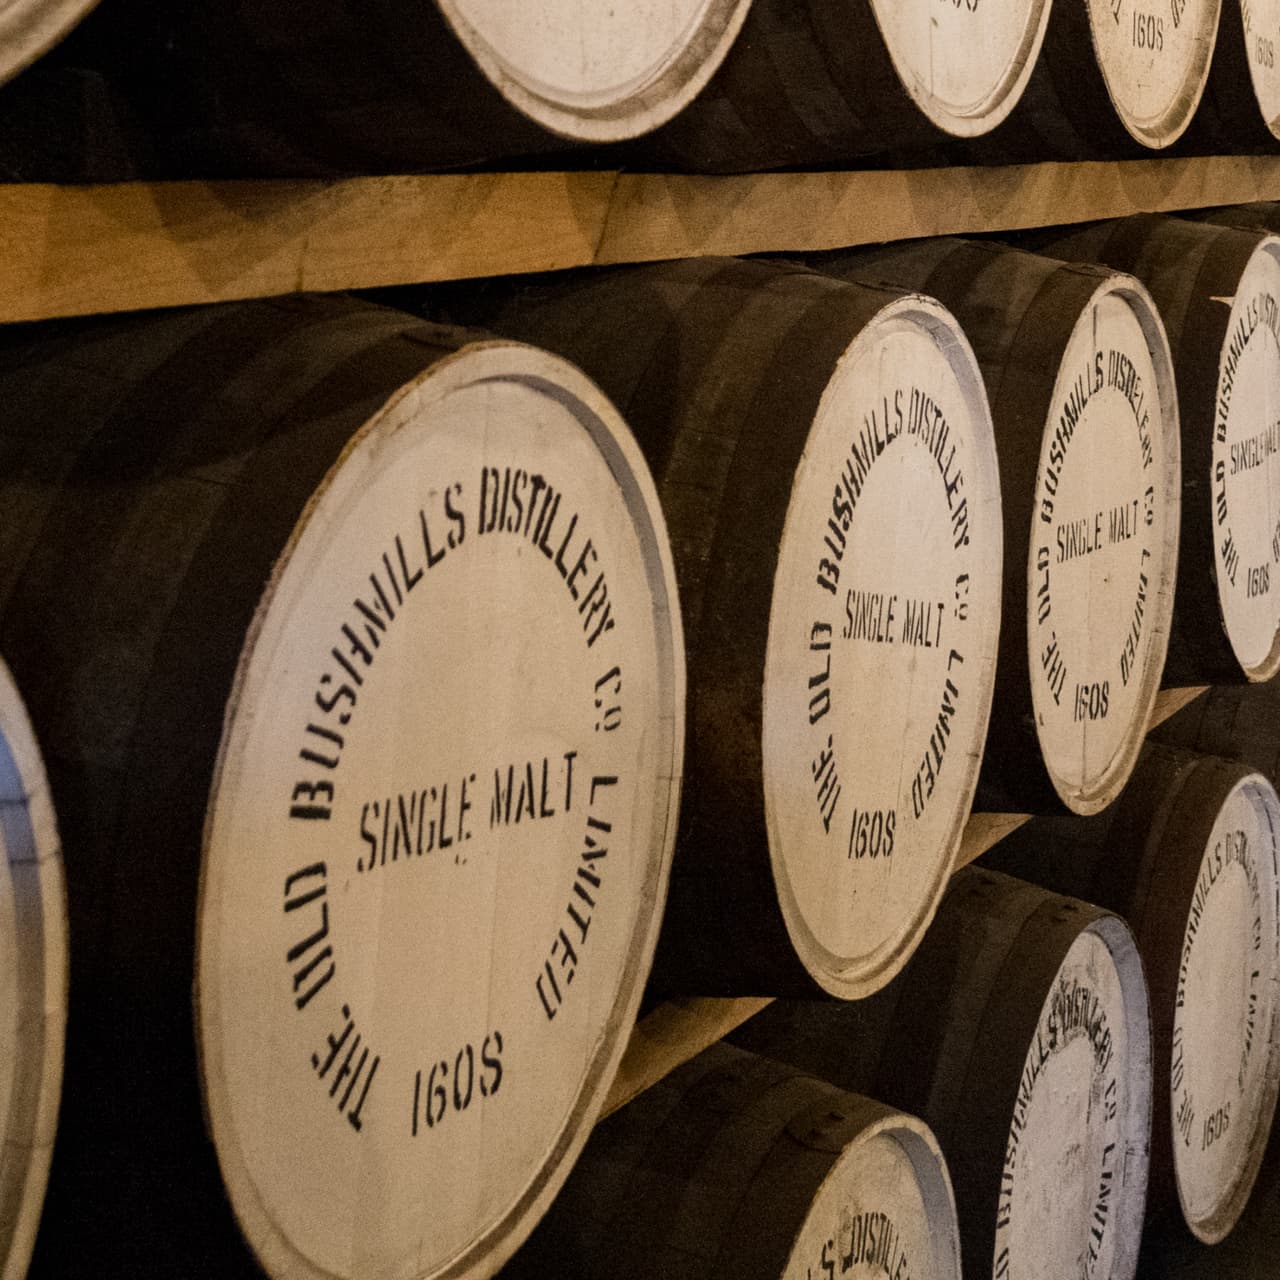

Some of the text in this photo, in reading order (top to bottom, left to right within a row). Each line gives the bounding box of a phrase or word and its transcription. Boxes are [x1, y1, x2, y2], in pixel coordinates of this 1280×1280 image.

[1108, 349, 1153, 472] DISTILLERY
[1216, 296, 1259, 444] BUSHMILLS
[816, 389, 903, 596] BUSHMILLS
[907, 386, 970, 550] DISTILLERY
[1041, 351, 1104, 524] BUSHMILLS
[1215, 458, 1228, 527] OLD
[478, 466, 617, 648] DISTILLERY
[1036, 545, 1052, 626] OLD
[1057, 498, 1138, 564] SINGLE MALT
[1222, 528, 1240, 588] THE
[289, 481, 466, 822] BUSHMILLS
[808, 621, 833, 726] OLD
[843, 588, 946, 649] SINGLE MALT
[1041, 632, 1067, 706] THE
[1120, 548, 1150, 687] LIMITED
[811, 733, 842, 834] THE
[913, 649, 964, 820] LIMITED
[356, 751, 579, 873] SINGLE MALT
[284, 860, 337, 1011] OLD
[534, 775, 619, 1021] LIMITED
[310, 1004, 381, 1133] THE
